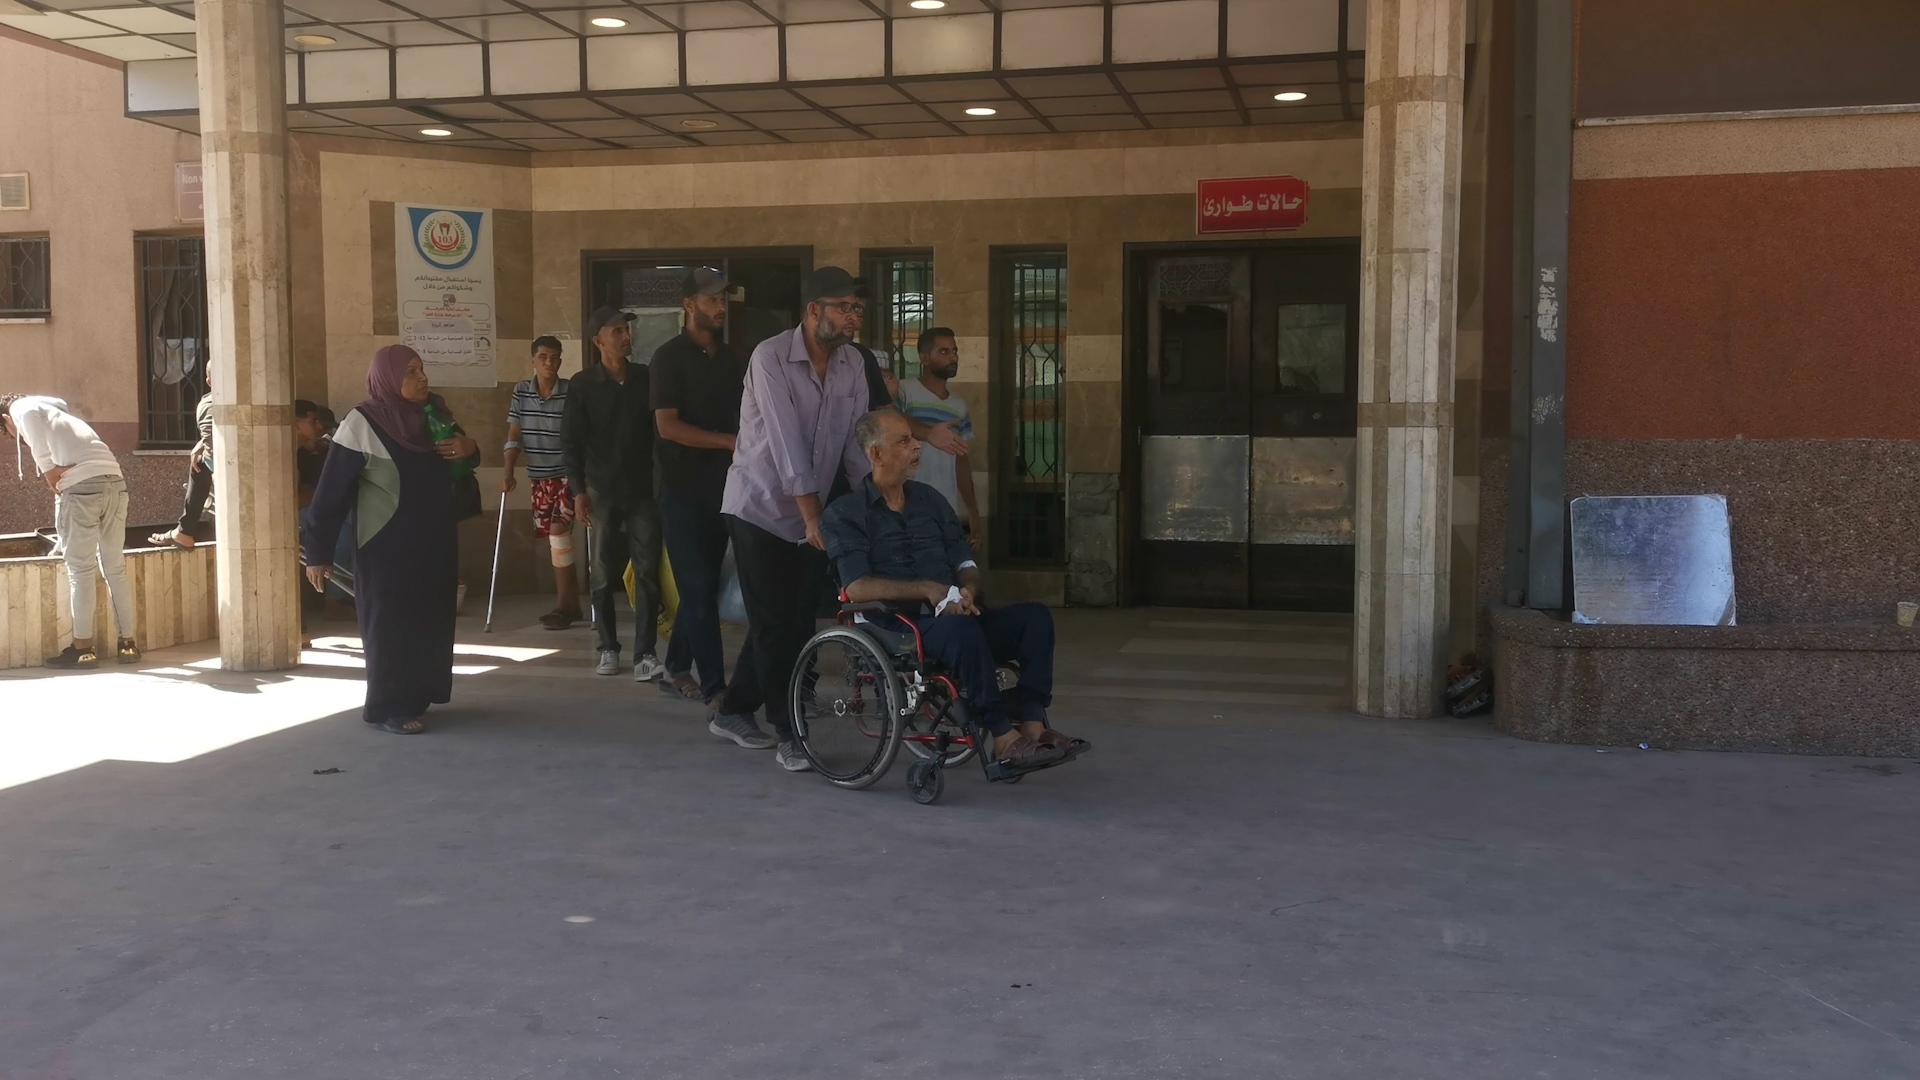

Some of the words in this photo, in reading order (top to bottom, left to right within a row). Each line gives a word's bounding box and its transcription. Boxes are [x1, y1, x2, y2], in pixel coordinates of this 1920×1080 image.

[182, 174, 198, 184] Non
[1203, 194, 1254, 217] طوارئ
[1257, 193, 1303, 211] حالات
[438, 235, 453, 244] 103
